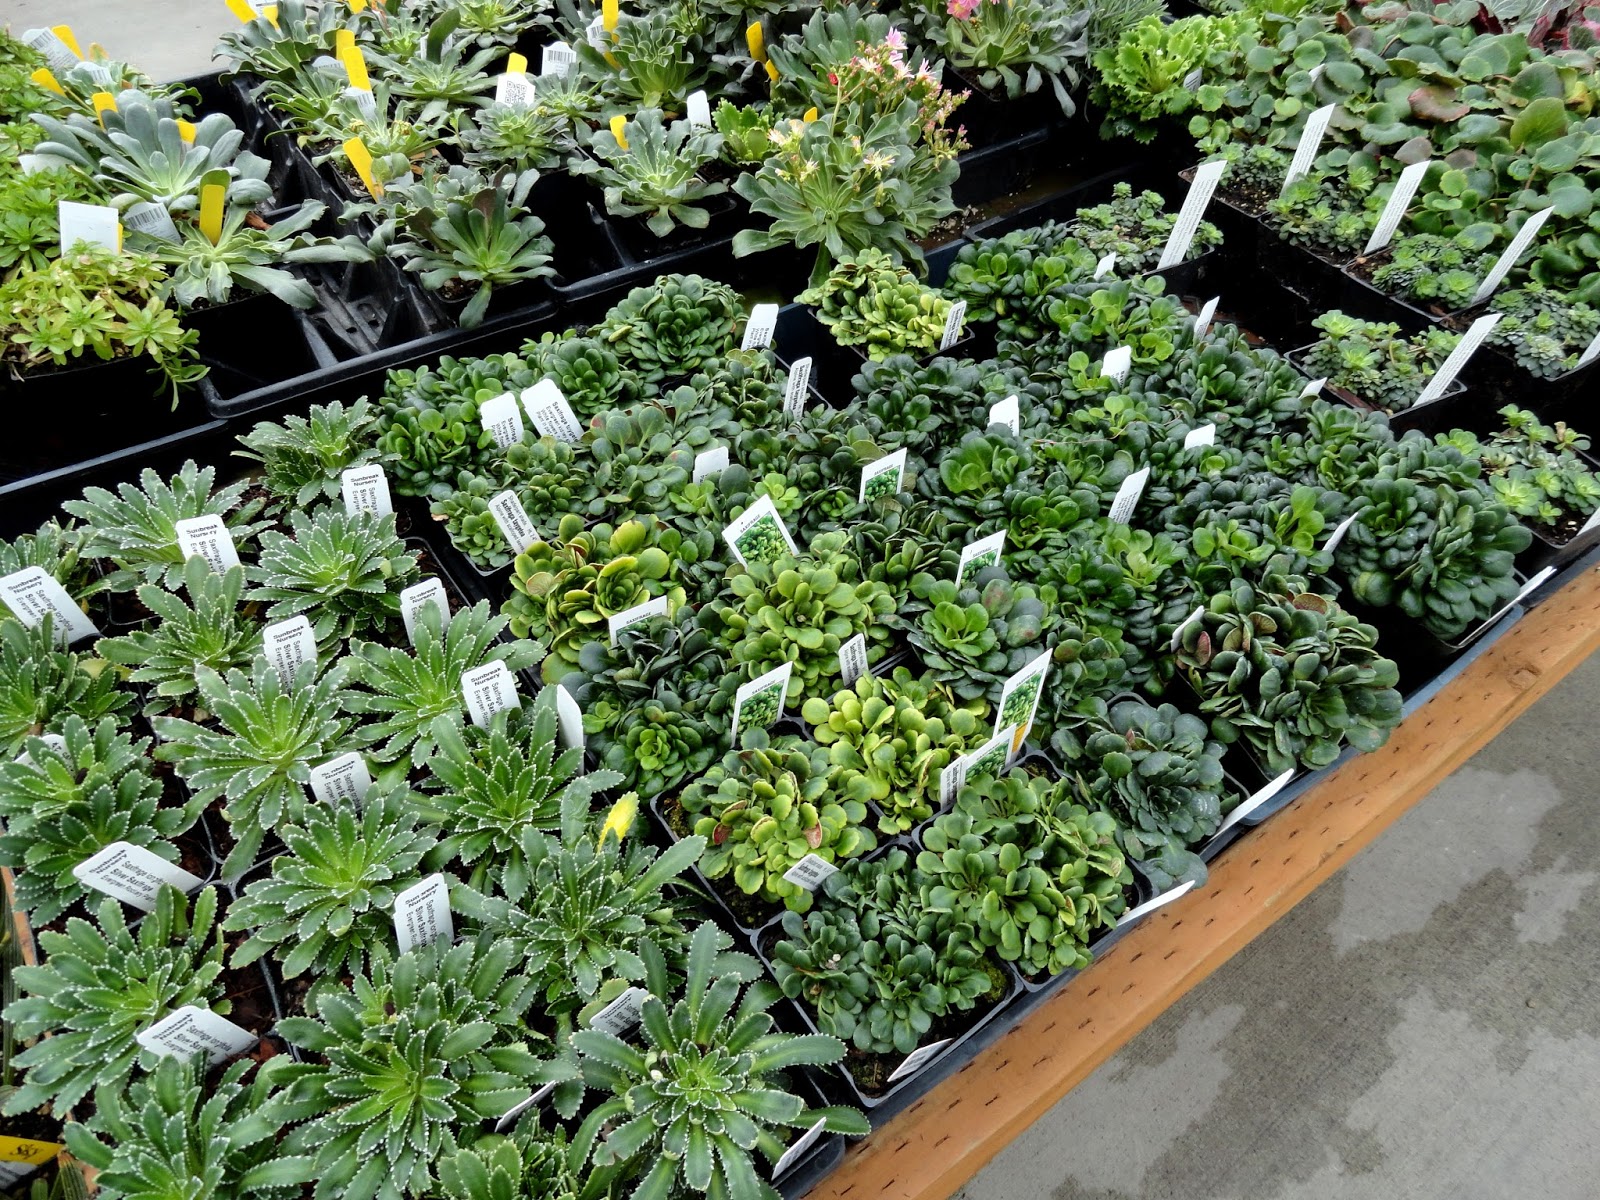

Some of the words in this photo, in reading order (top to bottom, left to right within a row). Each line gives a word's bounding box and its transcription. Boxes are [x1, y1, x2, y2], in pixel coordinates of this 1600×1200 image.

[351, 474, 379, 482] Sunbreak
[186, 524, 218, 534] Sunbreak
[190, 530, 217, 538] Nursery
[7, 575, 43, 590] Sunbreak
[13, 581, 42, 594] Nursery
[273, 625, 304, 640] Sunbreak
[276, 631, 303, 643] Nursery
[471, 667, 502, 682] Sunbreak
[474, 673, 500, 686] Nursery
[110, 868, 129, 880] Silver
[127, 876, 154, 892] Saxifrage
[408, 889, 437, 908] Nursery
